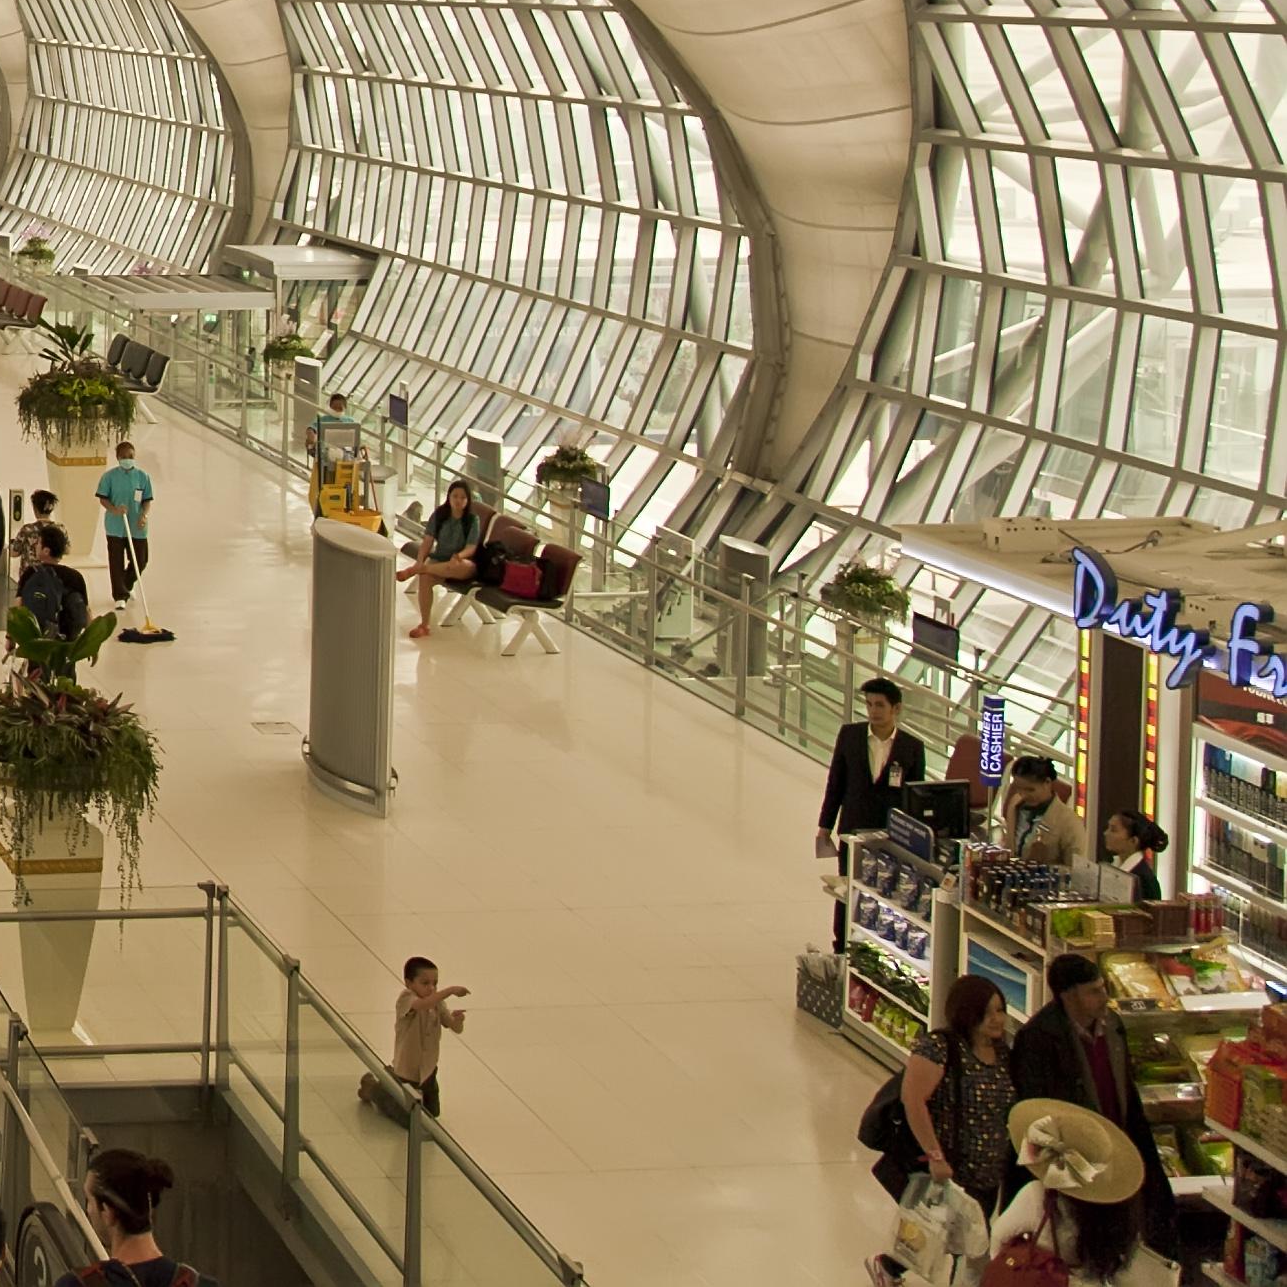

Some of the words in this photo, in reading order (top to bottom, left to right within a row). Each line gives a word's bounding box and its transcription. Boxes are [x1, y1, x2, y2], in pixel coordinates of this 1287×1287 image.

[1072, 546, 1203, 689] Duty
[980, 711, 991, 770] CASHIER
[989, 713, 1003, 772] CASHIER
